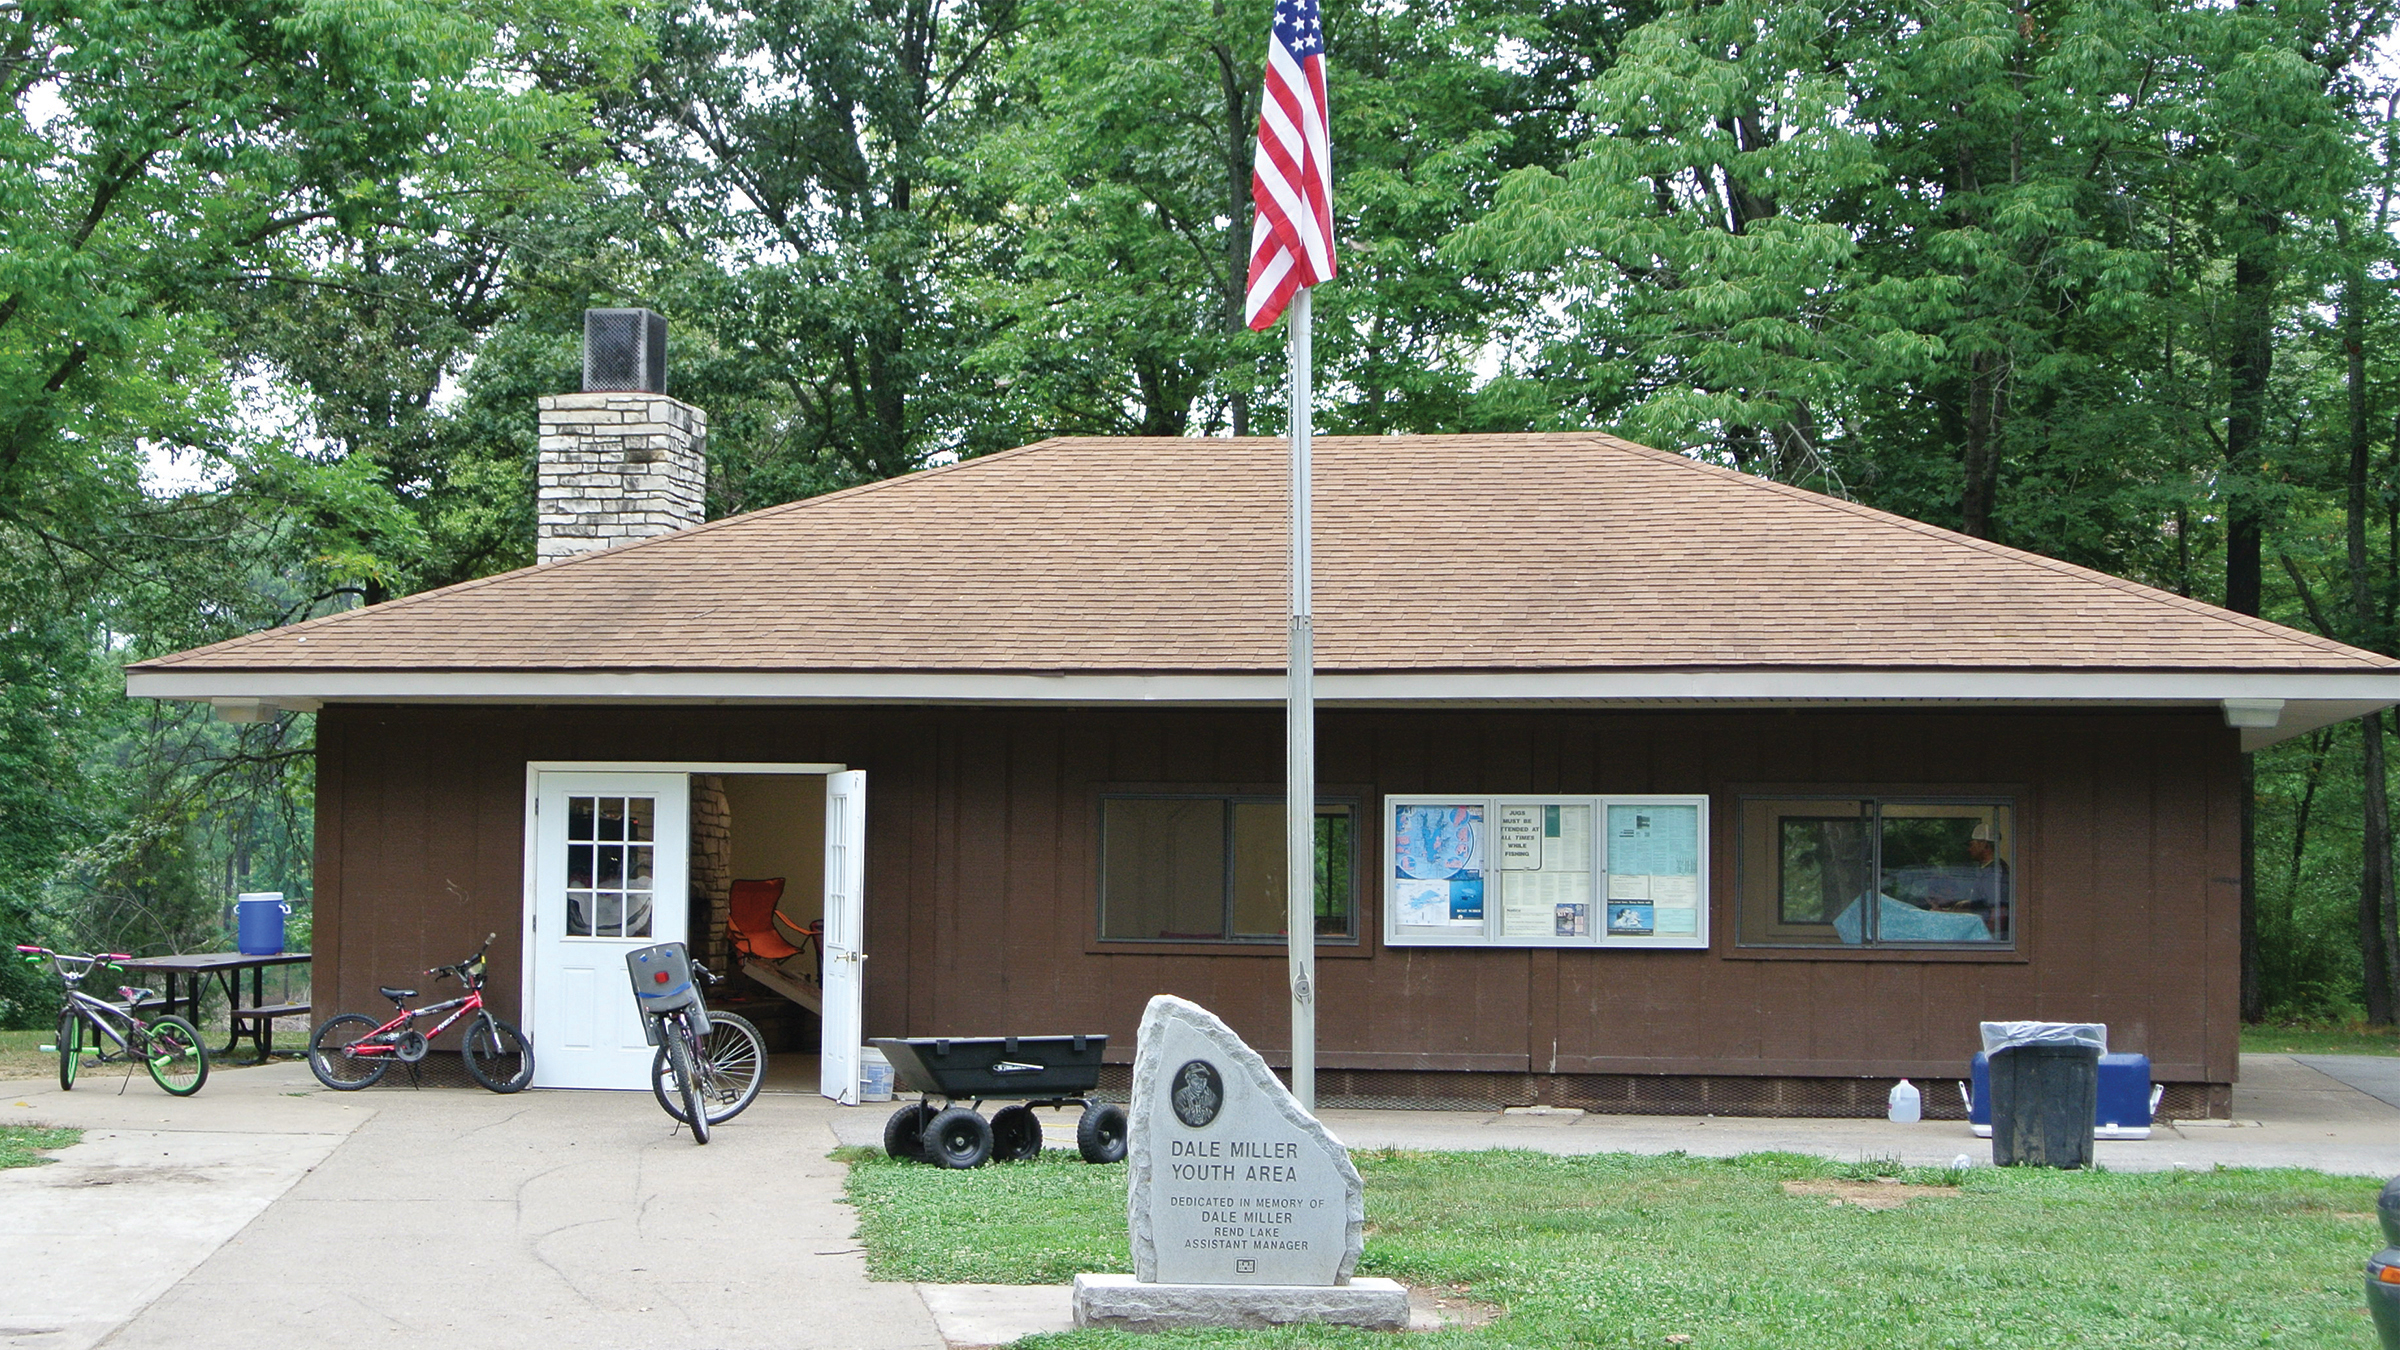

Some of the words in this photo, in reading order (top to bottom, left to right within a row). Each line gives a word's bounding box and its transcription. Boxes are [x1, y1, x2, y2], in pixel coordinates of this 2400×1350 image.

[437, 1010, 461, 1031] NEXT
[1172, 1140, 1221, 1158] DALE
[1230, 1141, 1298, 1159] MILLER
[1172, 1164, 1235, 1181] YOUTH
[1245, 1165, 1297, 1182] AREA
[1170, 1197, 1234, 1208] DEDICATED
[1240, 1198, 1250, 1208] IN
[1256, 1198, 1304, 1209] MEMORY
[1309, 1199, 1325, 1209] OF
[1201, 1211, 1237, 1223] DALE
[1244, 1212, 1292, 1224] MILLER
[1214, 1226, 1245, 1237] REND
[1250, 1227, 1279, 1237] LAKE
[1185, 1239, 1247, 1250] ASSISTANT
[1253, 1240, 1309, 1251] MANAGER
